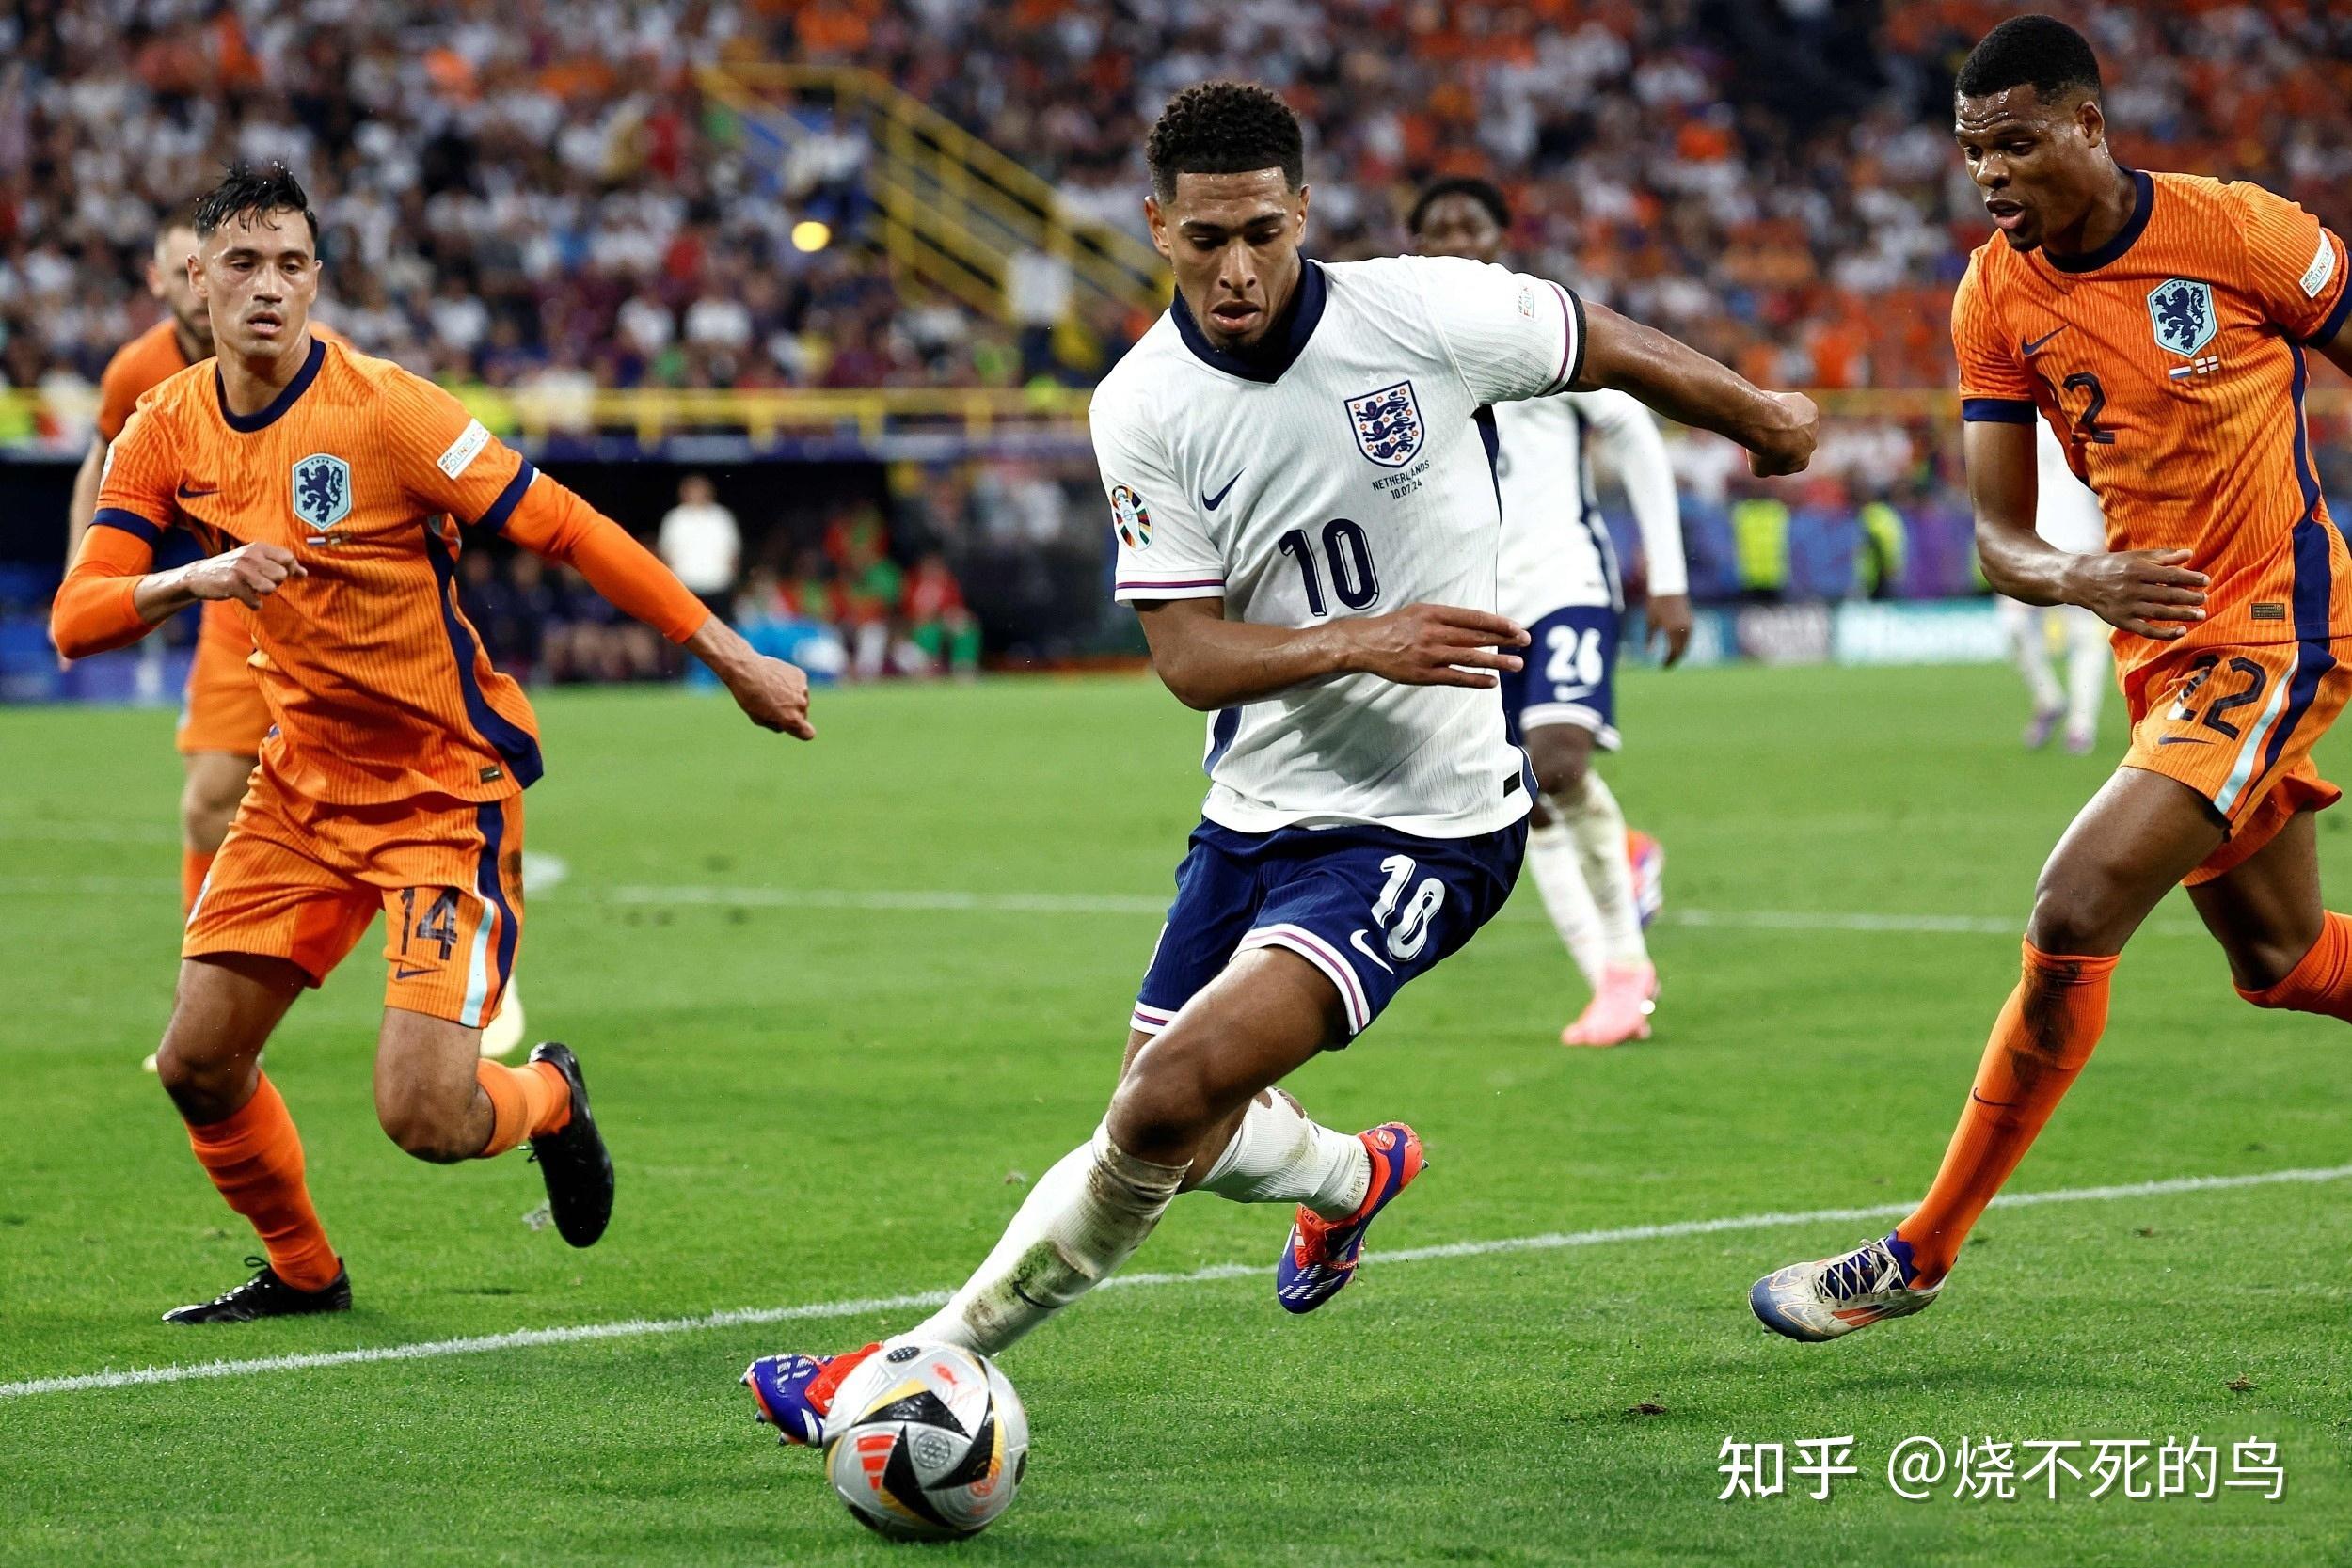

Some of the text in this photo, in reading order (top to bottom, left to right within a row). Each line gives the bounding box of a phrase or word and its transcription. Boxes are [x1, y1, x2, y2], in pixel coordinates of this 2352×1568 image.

[1372, 459, 1430, 491] NETHERLANDS
[1391, 478, 1422, 499] 10.07.24
[1278, 518, 1380, 617] 10
[1546, 625, 1603, 685] 26
[2167, 654, 2267, 741] 22
[400, 886, 460, 961] 14
[1371, 854, 1446, 961] 10
